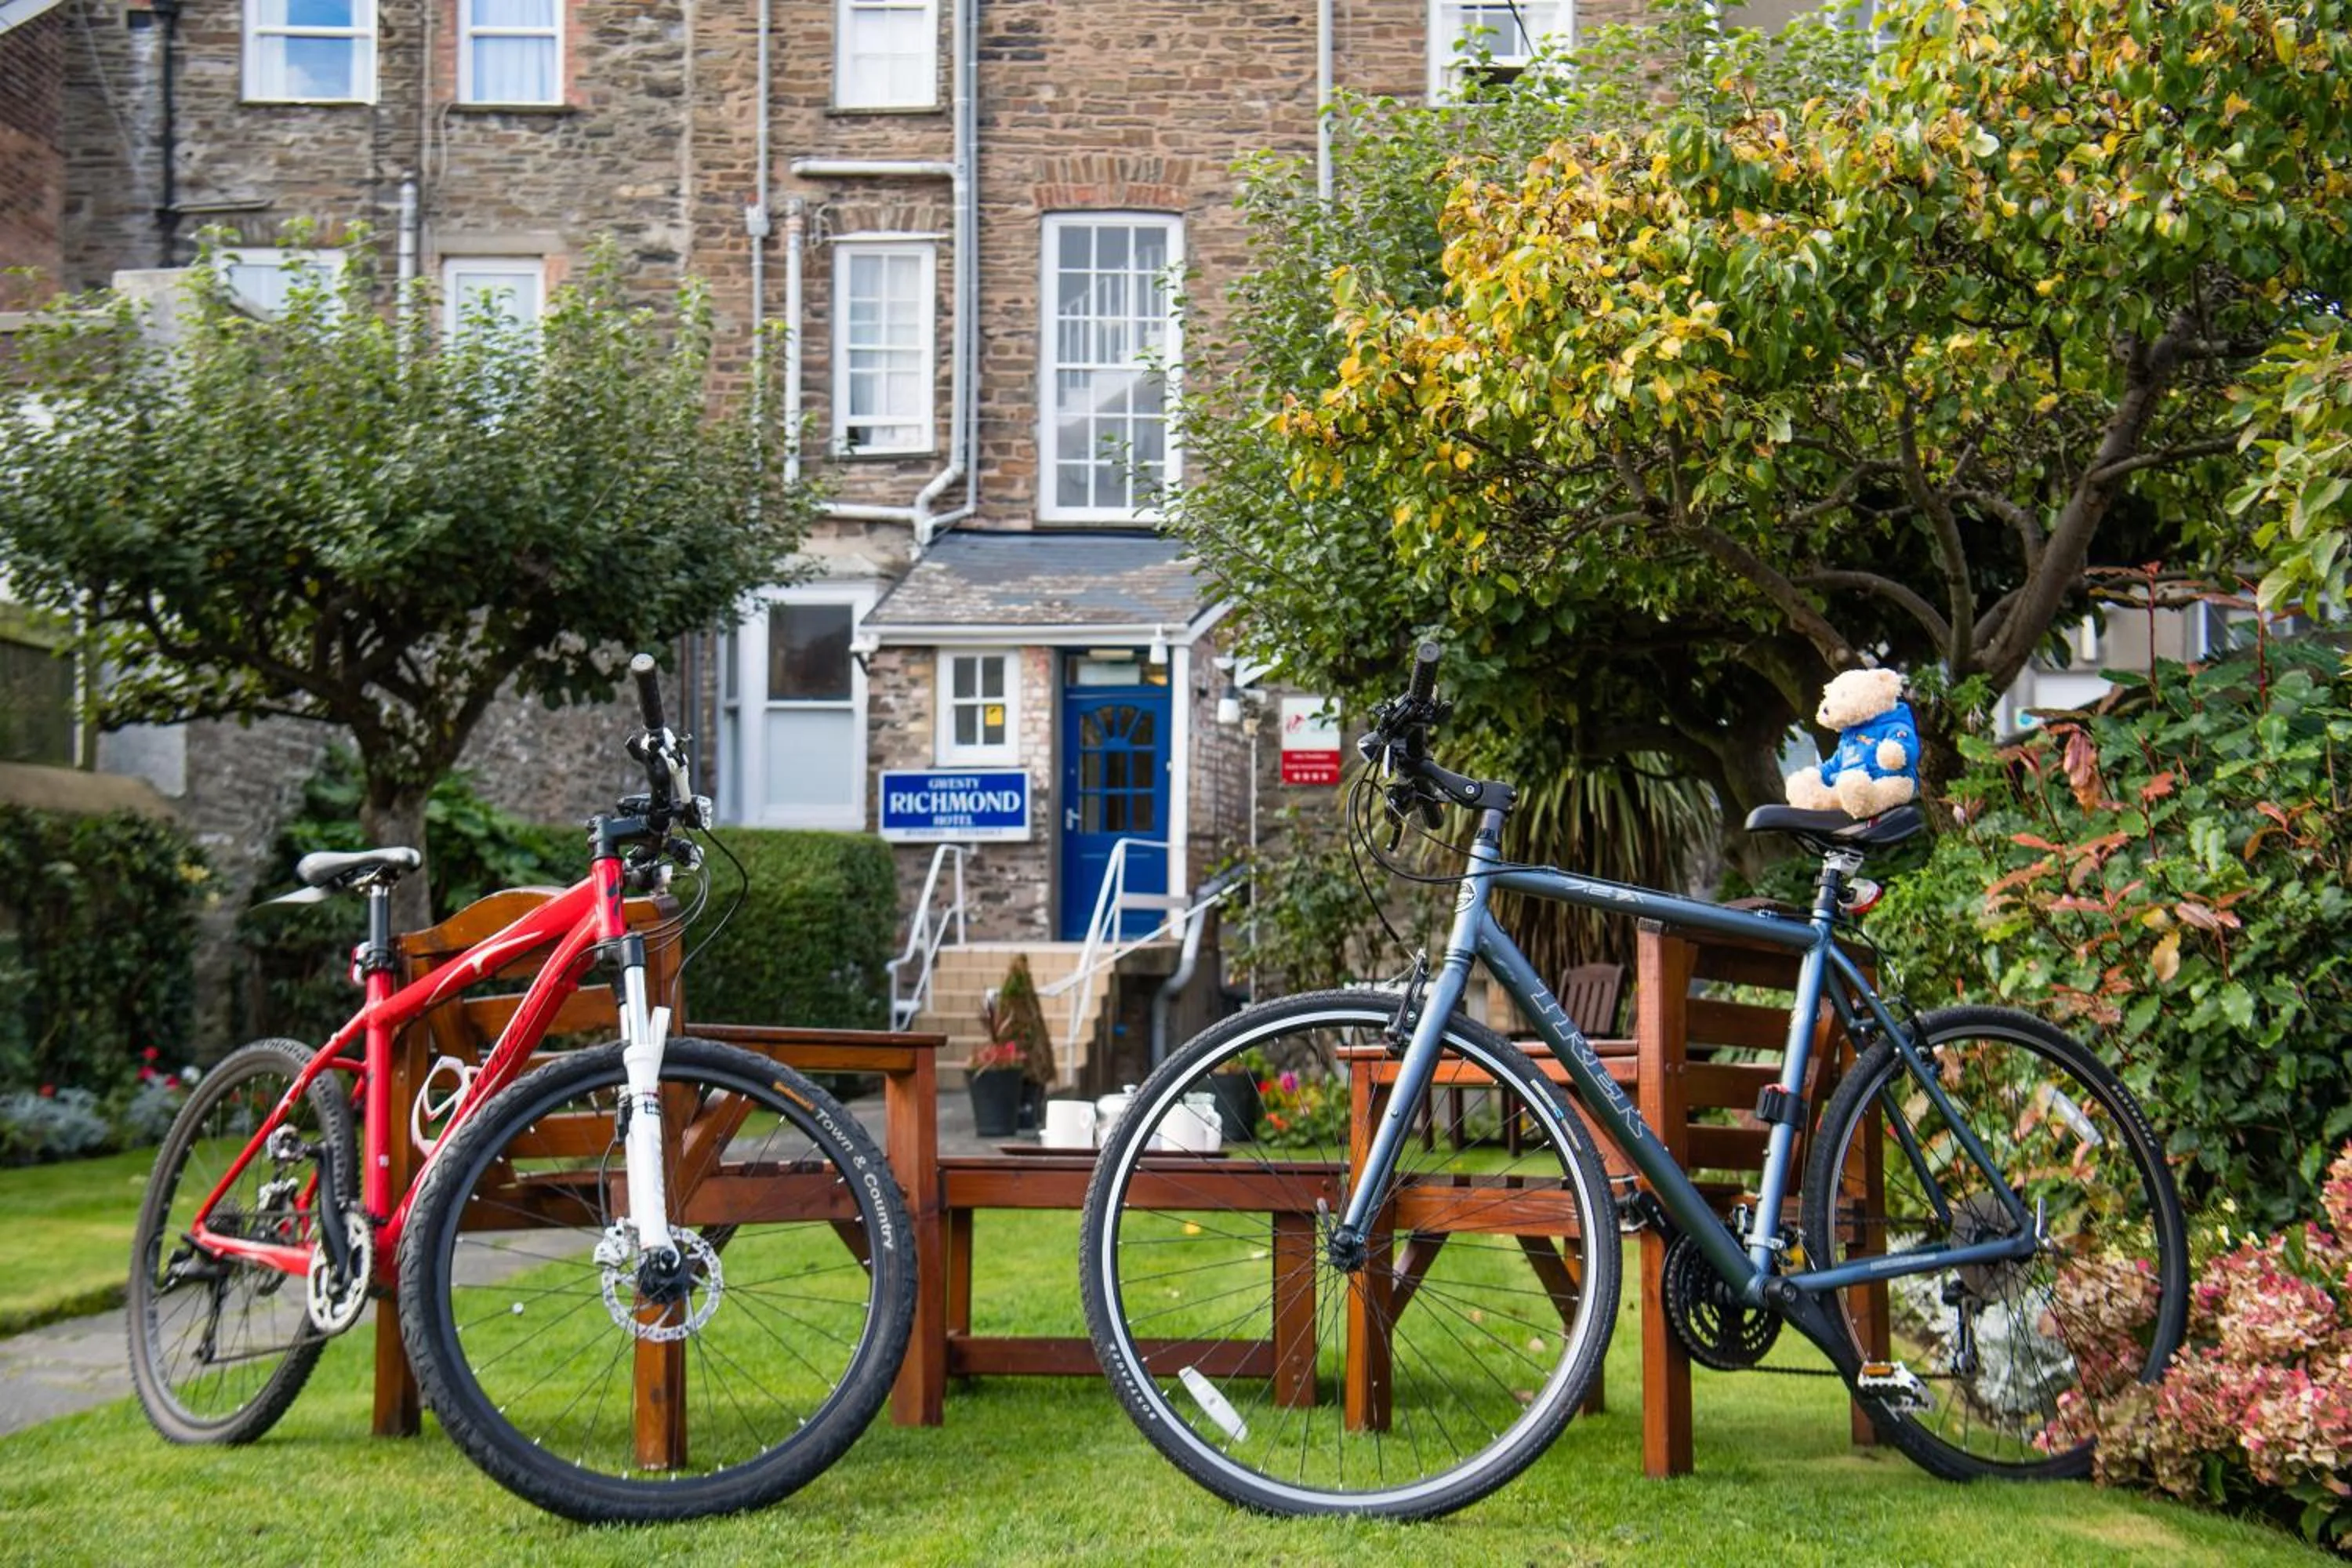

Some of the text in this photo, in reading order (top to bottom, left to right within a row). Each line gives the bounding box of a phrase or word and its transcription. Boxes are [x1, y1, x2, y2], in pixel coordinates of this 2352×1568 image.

[889, 790, 1021, 814] RICHMOND
[932, 815, 973, 826] HOTEL
[1530, 978, 1648, 1139] TREK
[815, 1108, 894, 1250] Town & Country
